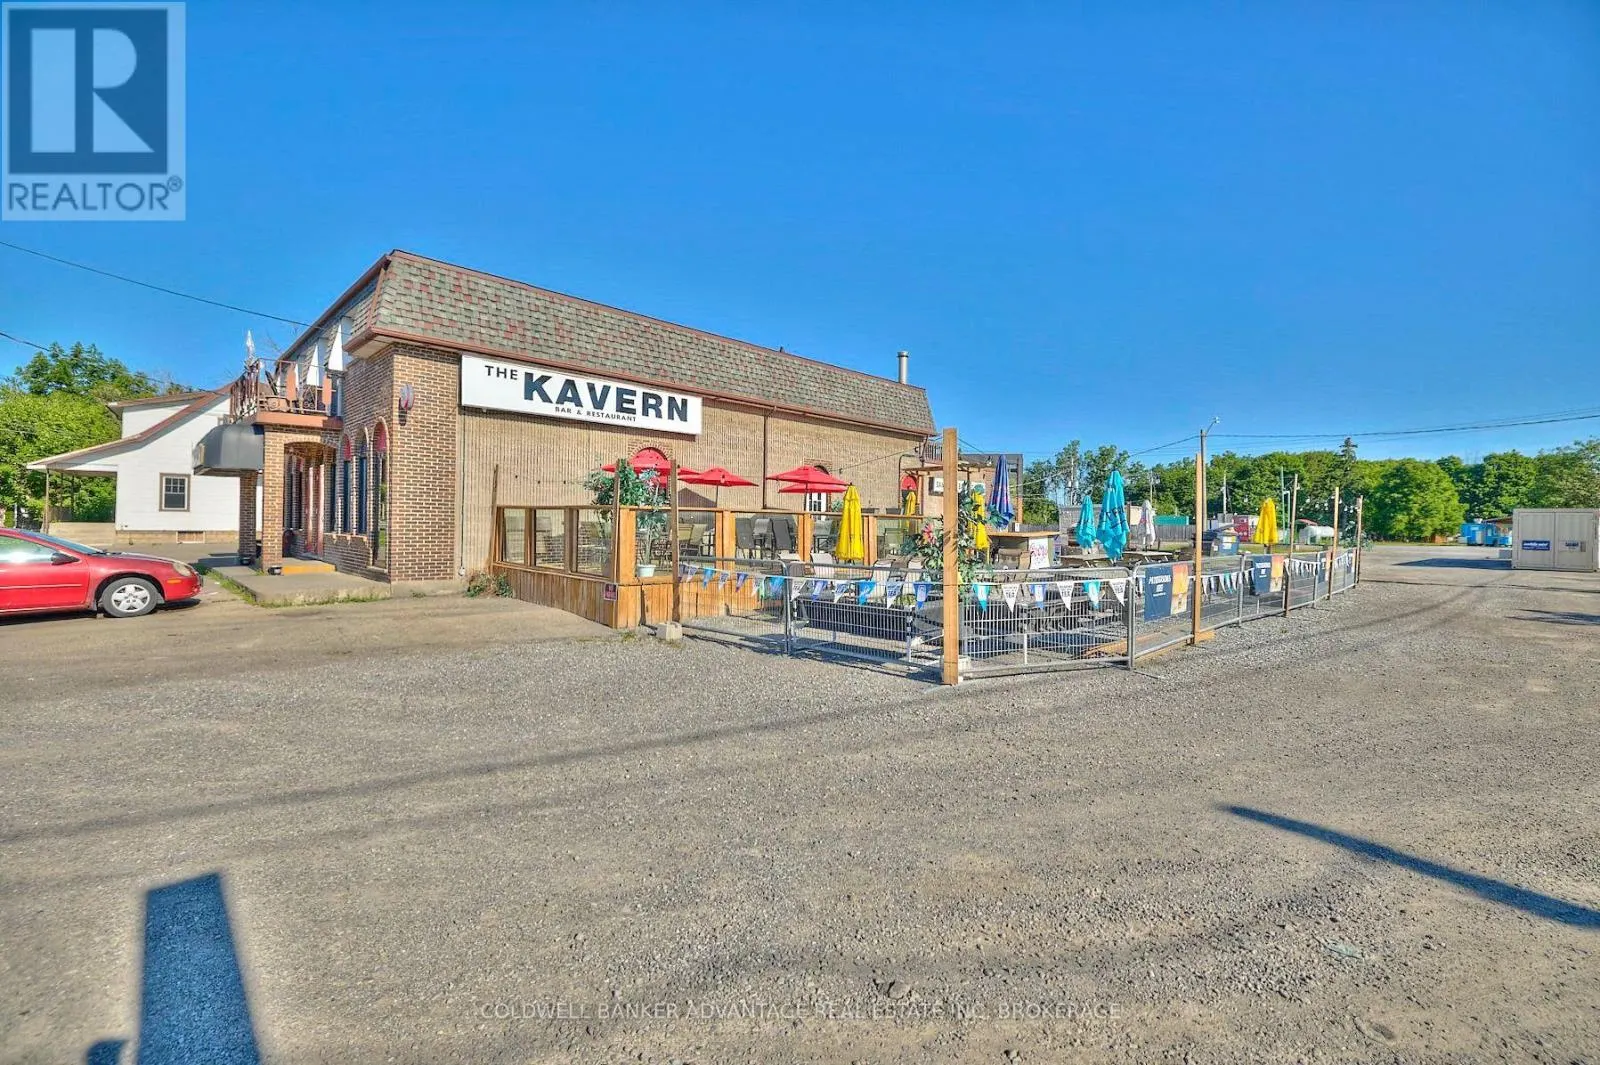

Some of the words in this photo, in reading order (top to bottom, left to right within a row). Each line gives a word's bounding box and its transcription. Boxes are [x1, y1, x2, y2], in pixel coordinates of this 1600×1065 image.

[484, 365, 519, 381] THE
[524, 372, 688, 422] KAVERN
[555, 406, 572, 414] BAR
[587, 410, 637, 422] RESTAURANT
